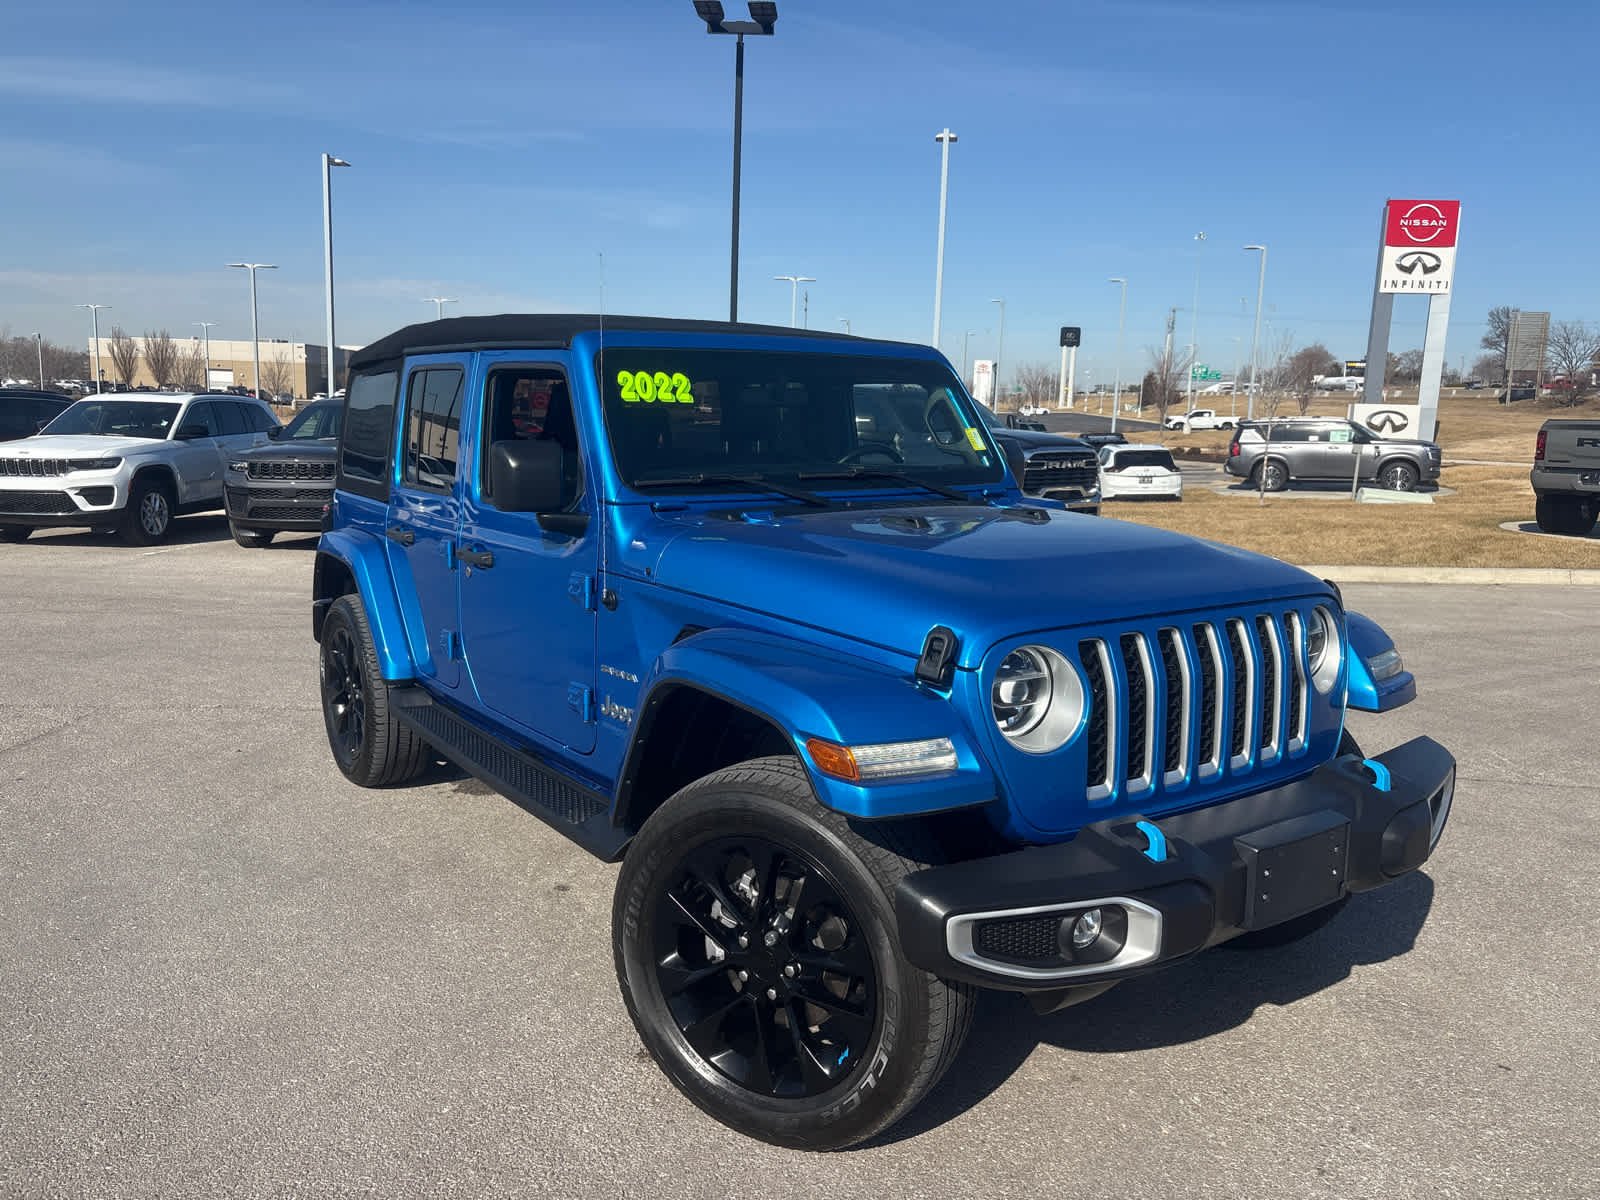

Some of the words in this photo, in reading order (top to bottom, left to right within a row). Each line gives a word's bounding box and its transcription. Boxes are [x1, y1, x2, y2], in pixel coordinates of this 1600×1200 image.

[1384, 280, 1448, 289] INFINITI
[617, 370, 694, 403] 2022
[600, 695, 634, 727] Jeep
